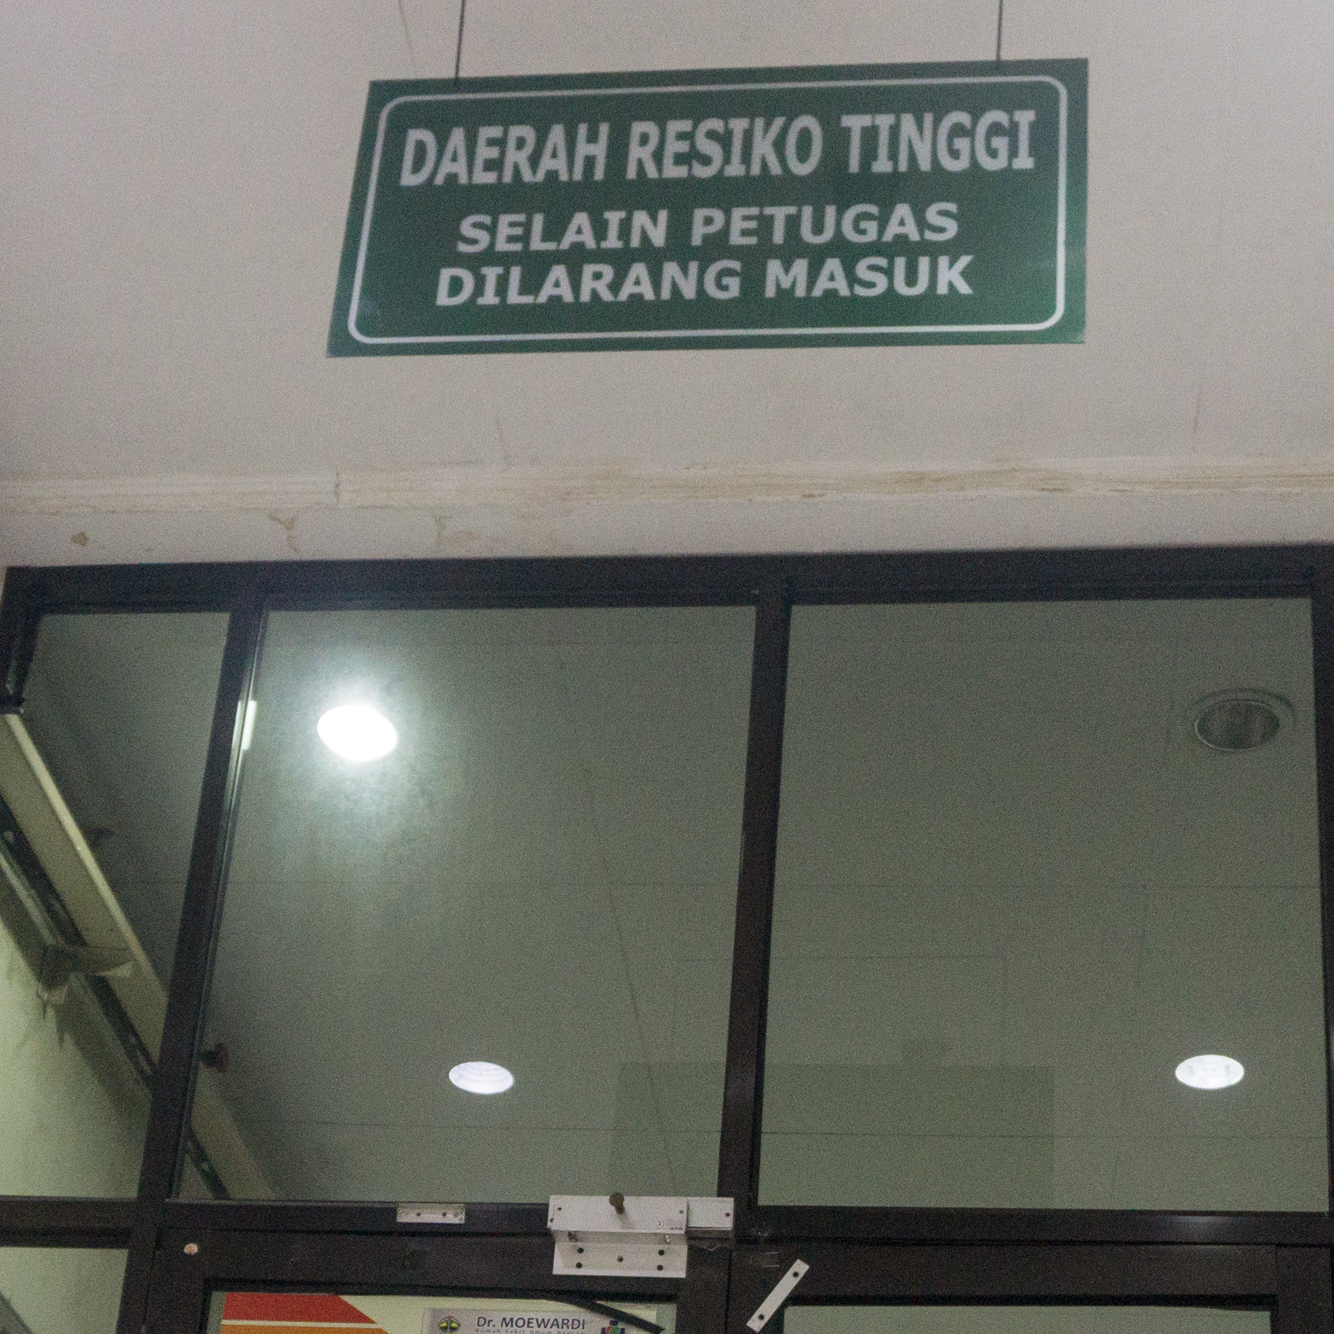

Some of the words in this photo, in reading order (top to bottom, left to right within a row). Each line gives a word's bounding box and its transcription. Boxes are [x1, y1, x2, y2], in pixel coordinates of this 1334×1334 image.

[399, 121, 609, 188] DAERAH
[625, 115, 824, 181] RESIKO
[840, 108, 1037, 174] TINGGI
[457, 209, 669, 254] SELAIN
[690, 201, 960, 246] PETUGAS
[435, 259, 742, 306] DILARANG
[766, 254, 975, 299] MASUK
[476, 1316, 496, 1328] Dr.
[500, 1317, 586, 1330] MOEWARDI
